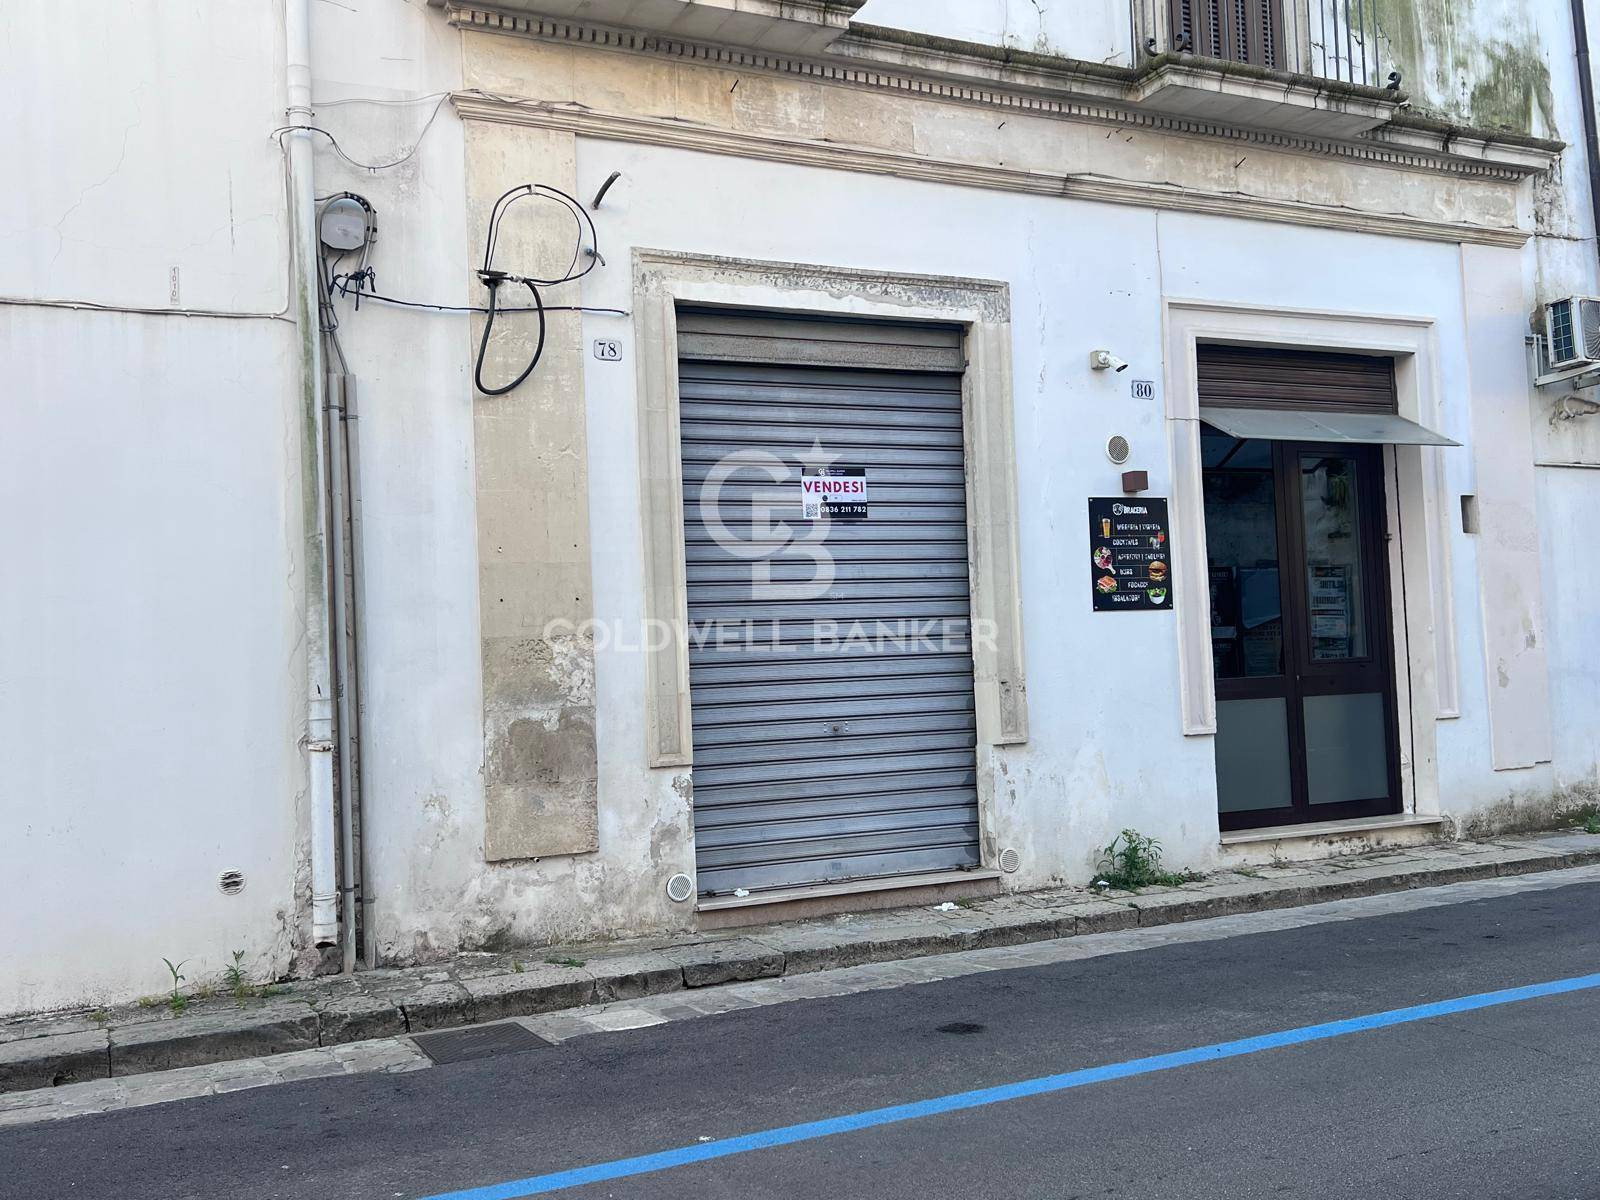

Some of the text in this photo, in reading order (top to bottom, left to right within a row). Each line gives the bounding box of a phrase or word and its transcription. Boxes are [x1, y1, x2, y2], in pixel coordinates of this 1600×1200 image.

[598, 342, 617, 357] 78
[1136, 382, 1151, 398] 80
[803, 481, 864, 493] VENDESI
[1123, 506, 1148, 514] BRACERIA
